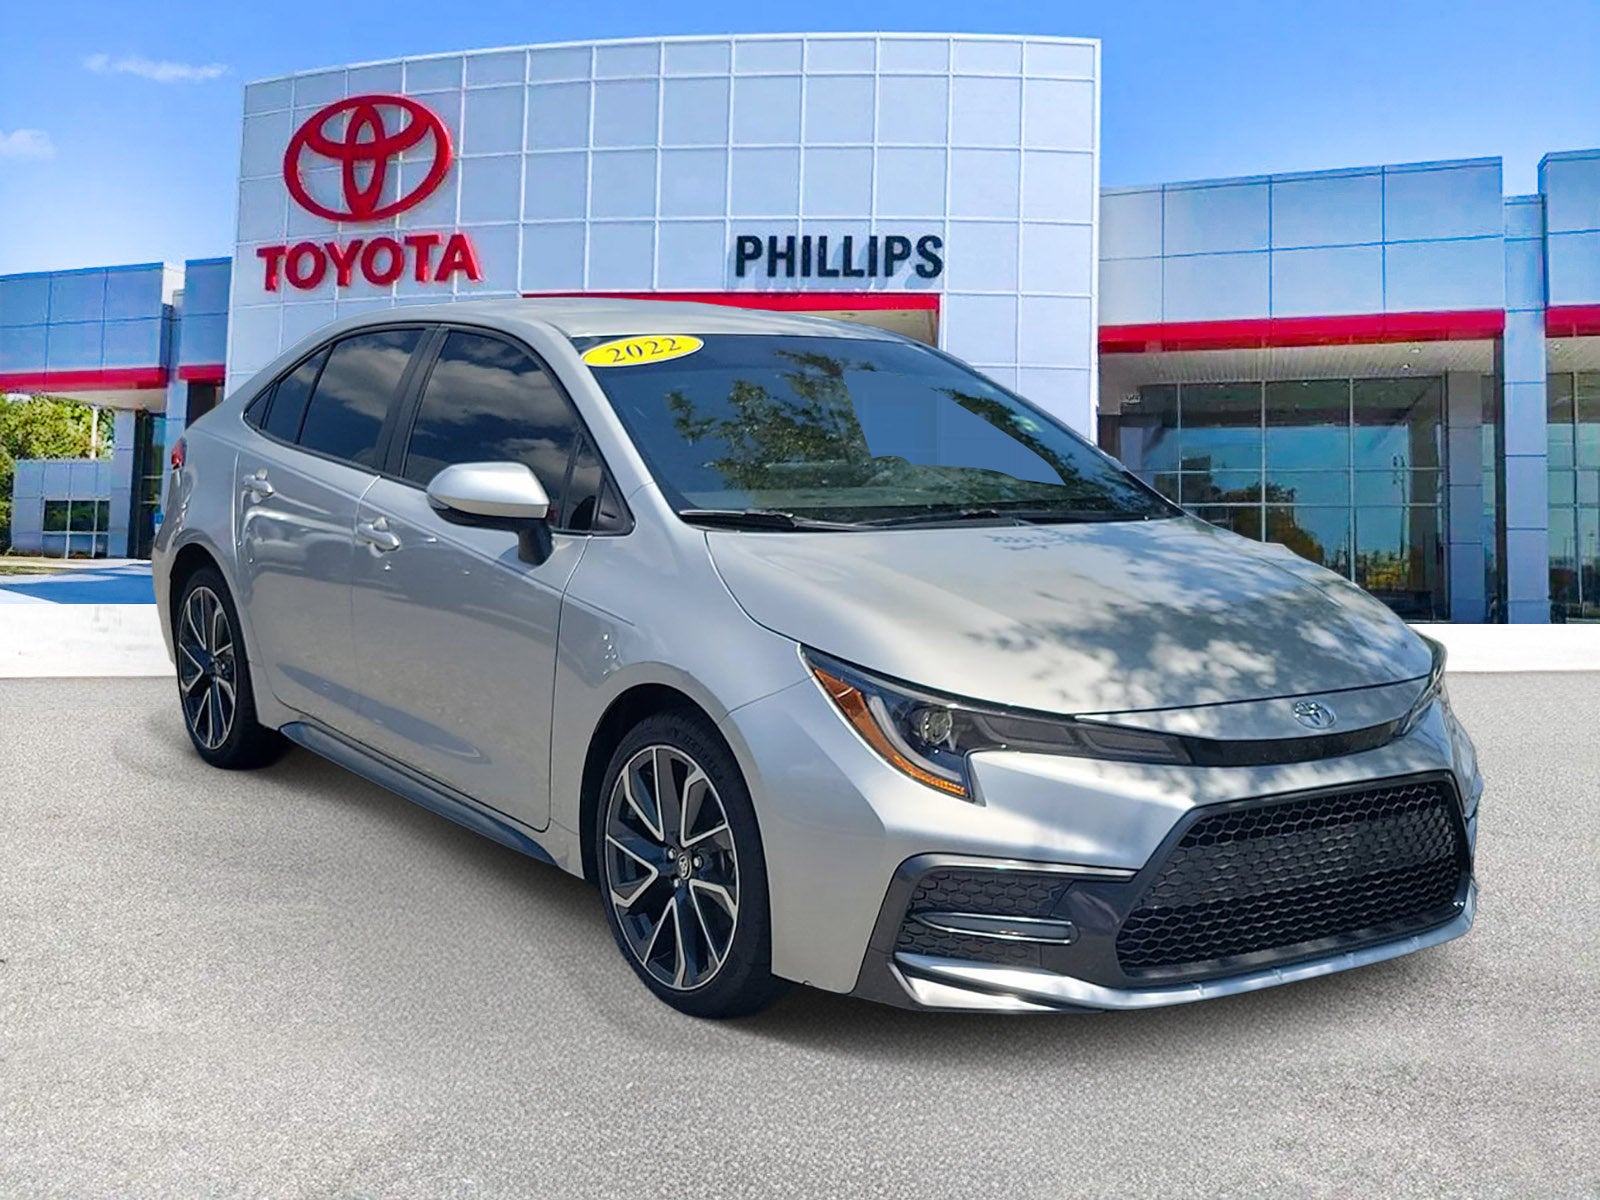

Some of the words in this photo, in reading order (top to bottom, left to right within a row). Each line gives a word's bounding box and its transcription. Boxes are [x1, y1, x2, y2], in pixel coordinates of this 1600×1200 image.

[256, 234, 482, 291] TOYOTA
[735, 235, 943, 278] PHILLIPS
[607, 337, 682, 362] 2022
